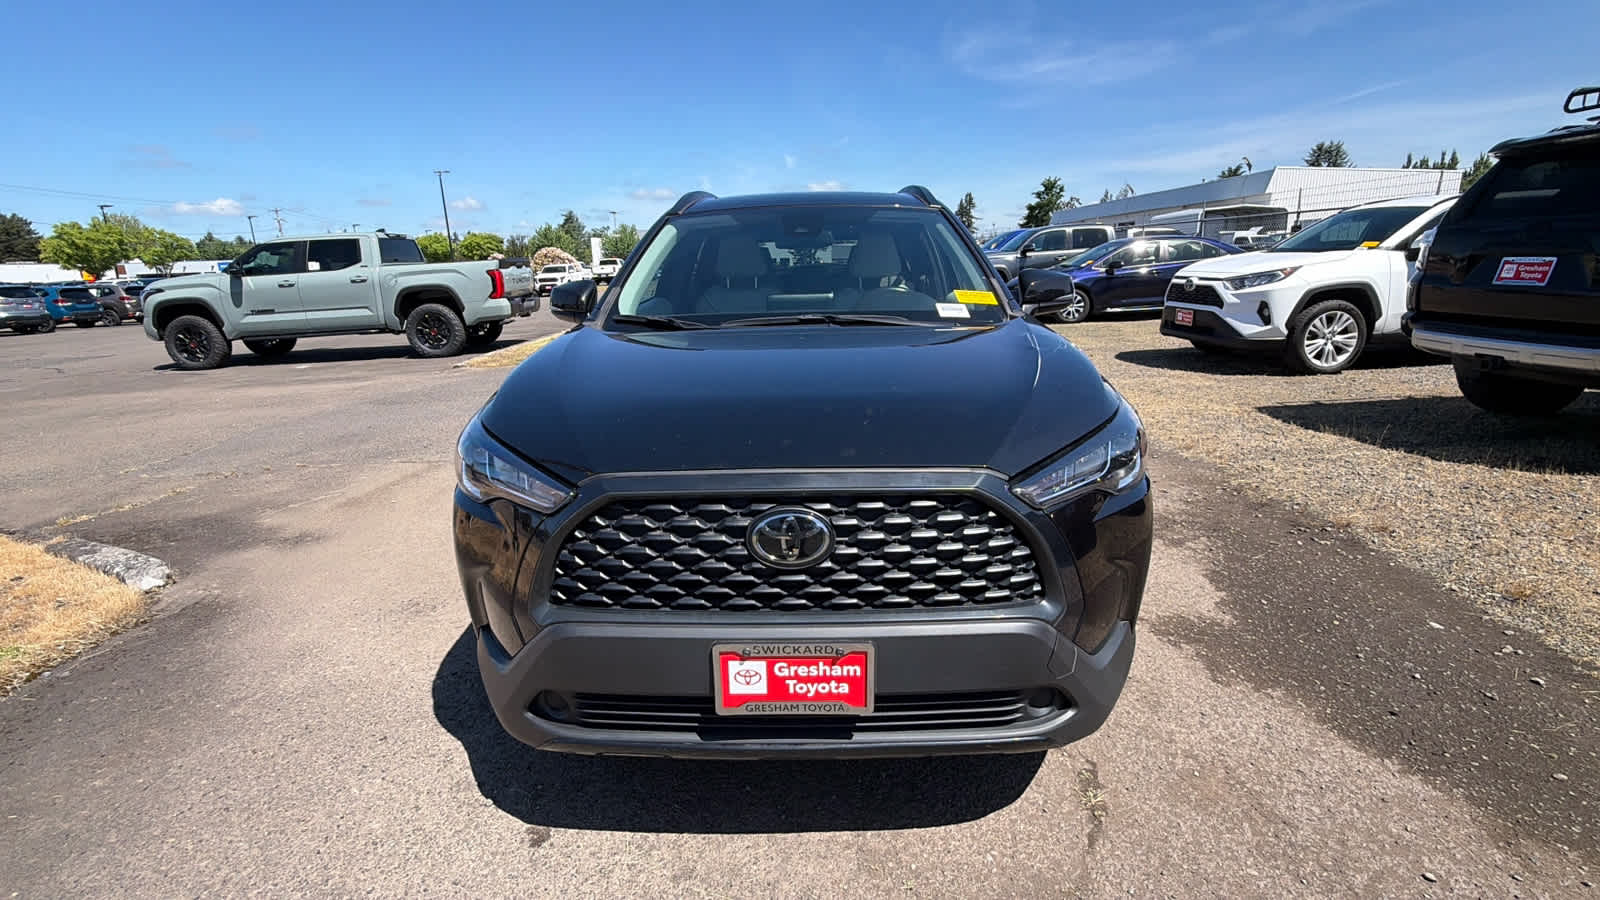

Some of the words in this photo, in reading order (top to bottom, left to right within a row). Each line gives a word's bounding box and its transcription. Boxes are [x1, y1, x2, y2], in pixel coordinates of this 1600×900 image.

[752, 645, 834, 655] SWICKARD
[774, 661, 861, 676] Gresham
[785, 679, 848, 697] Toyota
[745, 704, 800, 713] GRESHAM
[803, 704, 844, 713] TOYOTA
